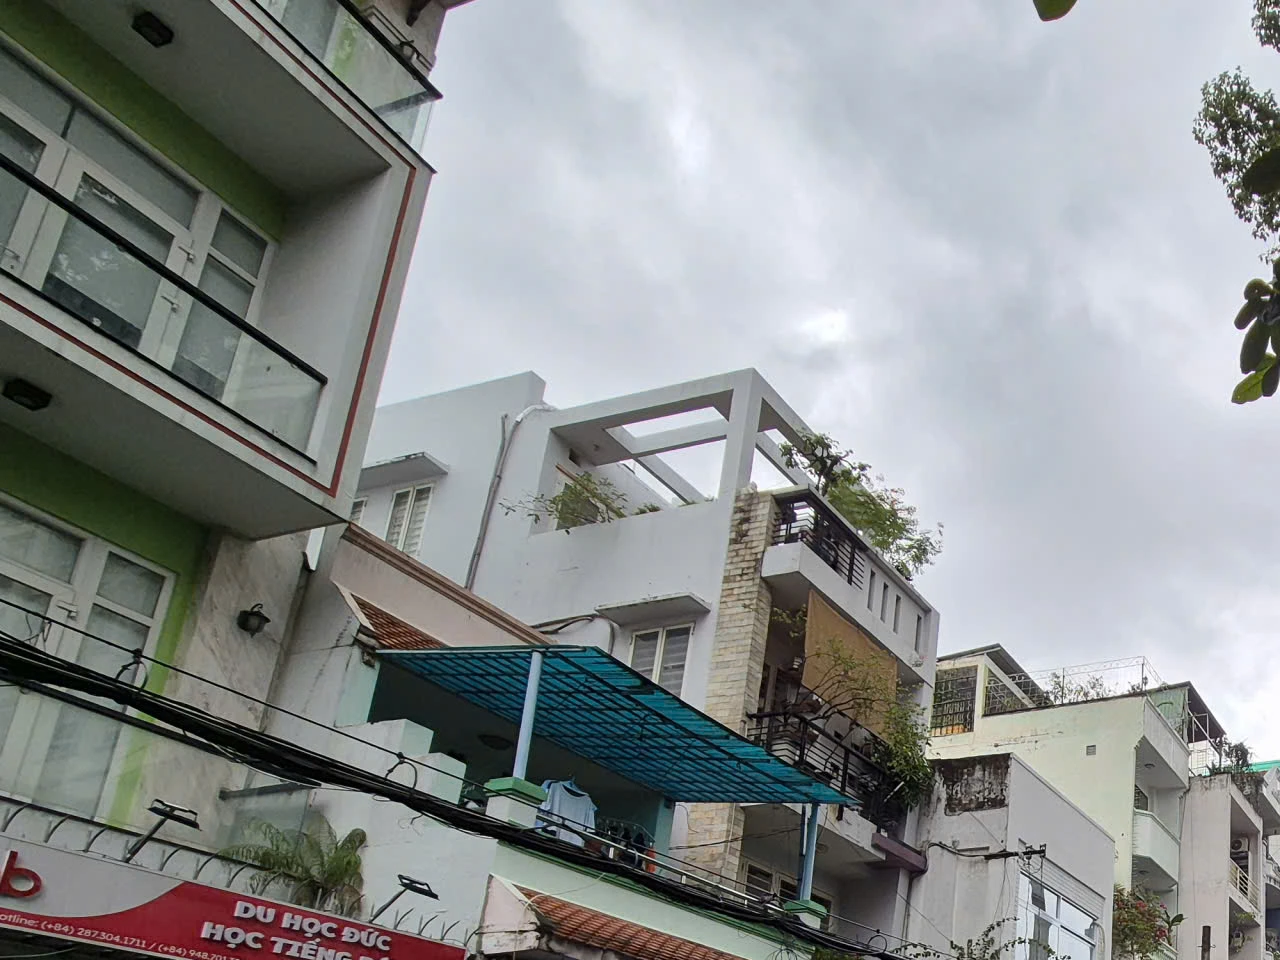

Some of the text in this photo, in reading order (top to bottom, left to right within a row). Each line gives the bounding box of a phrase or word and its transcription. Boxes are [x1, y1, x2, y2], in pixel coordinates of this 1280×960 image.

[40, 921, 75, 935] (+84)
[77, 927, 146, 948] 287.304.1711
[158, 943, 187, 957] (+84)
[201, 921, 265, 949] HỌC
[234, 900, 392, 951] DU HỌC ĐỨC
